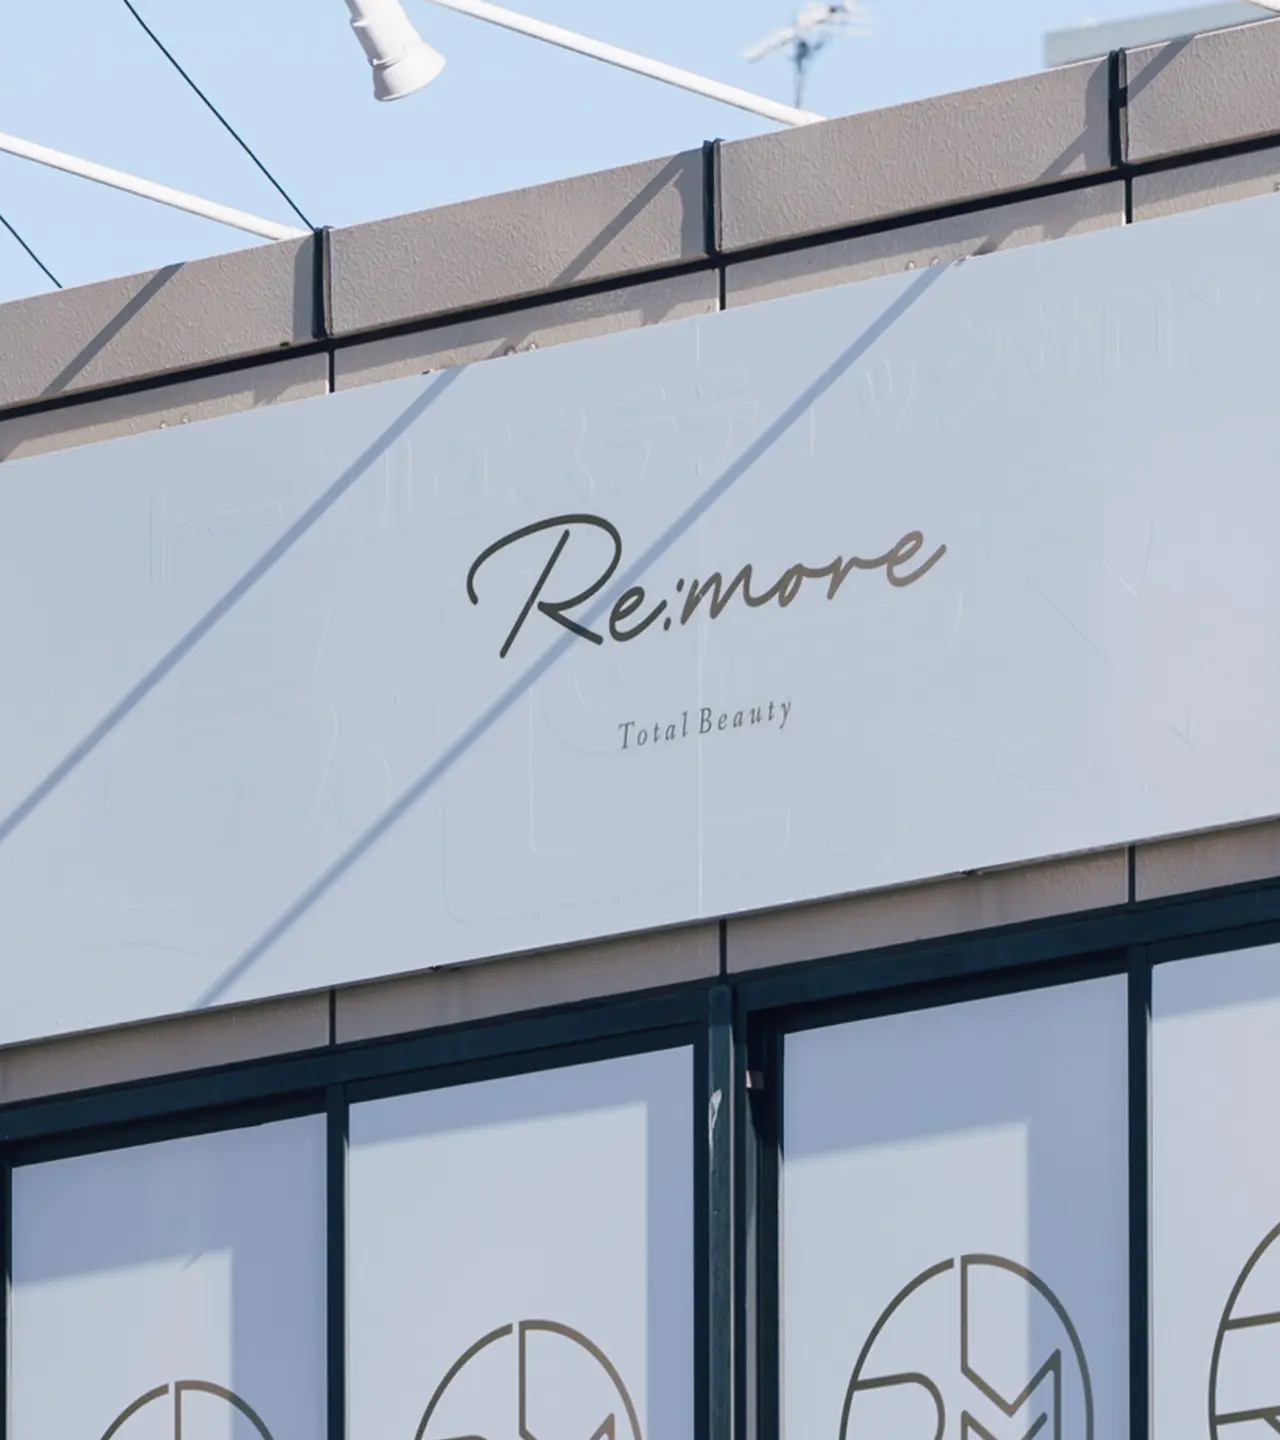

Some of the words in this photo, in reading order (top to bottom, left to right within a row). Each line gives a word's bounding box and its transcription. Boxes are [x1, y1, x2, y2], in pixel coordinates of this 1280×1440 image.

[466, 513, 947, 660] Re:more
[618, 710, 689, 750] Total
[698, 700, 792, 736] Beauty
